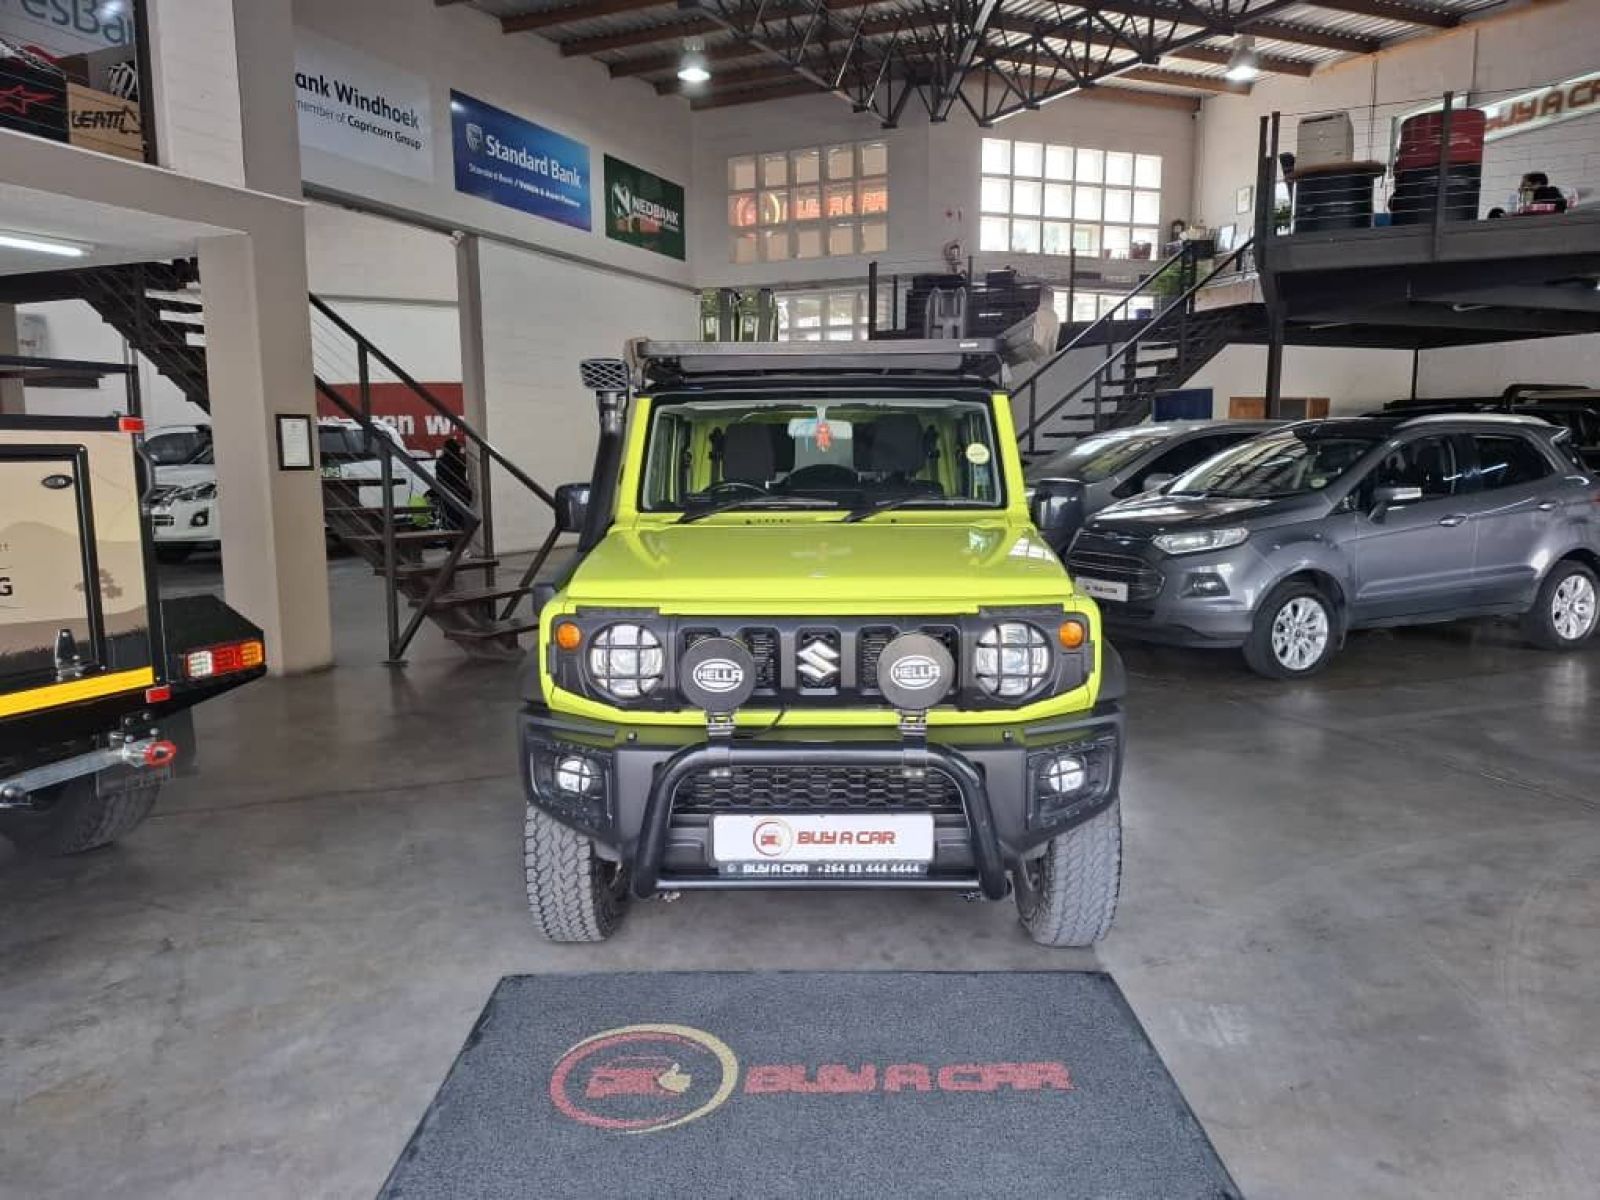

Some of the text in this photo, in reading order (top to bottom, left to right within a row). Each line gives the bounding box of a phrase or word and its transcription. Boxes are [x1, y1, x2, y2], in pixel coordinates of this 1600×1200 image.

[294, 72, 420, 129] ank Windhoek
[347, 115, 393, 140] Capricorn
[395, 131, 422, 151] Group
[486, 135, 549, 177] Standard
[551, 160, 581, 188] Bank
[631, 195, 679, 226] NEDBANK
[697, 668, 743, 682] HELLA
[895, 664, 941, 680] HELLA
[797, 831, 896, 845] BUY A CAR
[743, 864, 770, 873] BUY
[772, 864, 781, 873] A
[782, 864, 809, 873] CAR
[743, 1062, 1075, 1094] BUY A CAR
